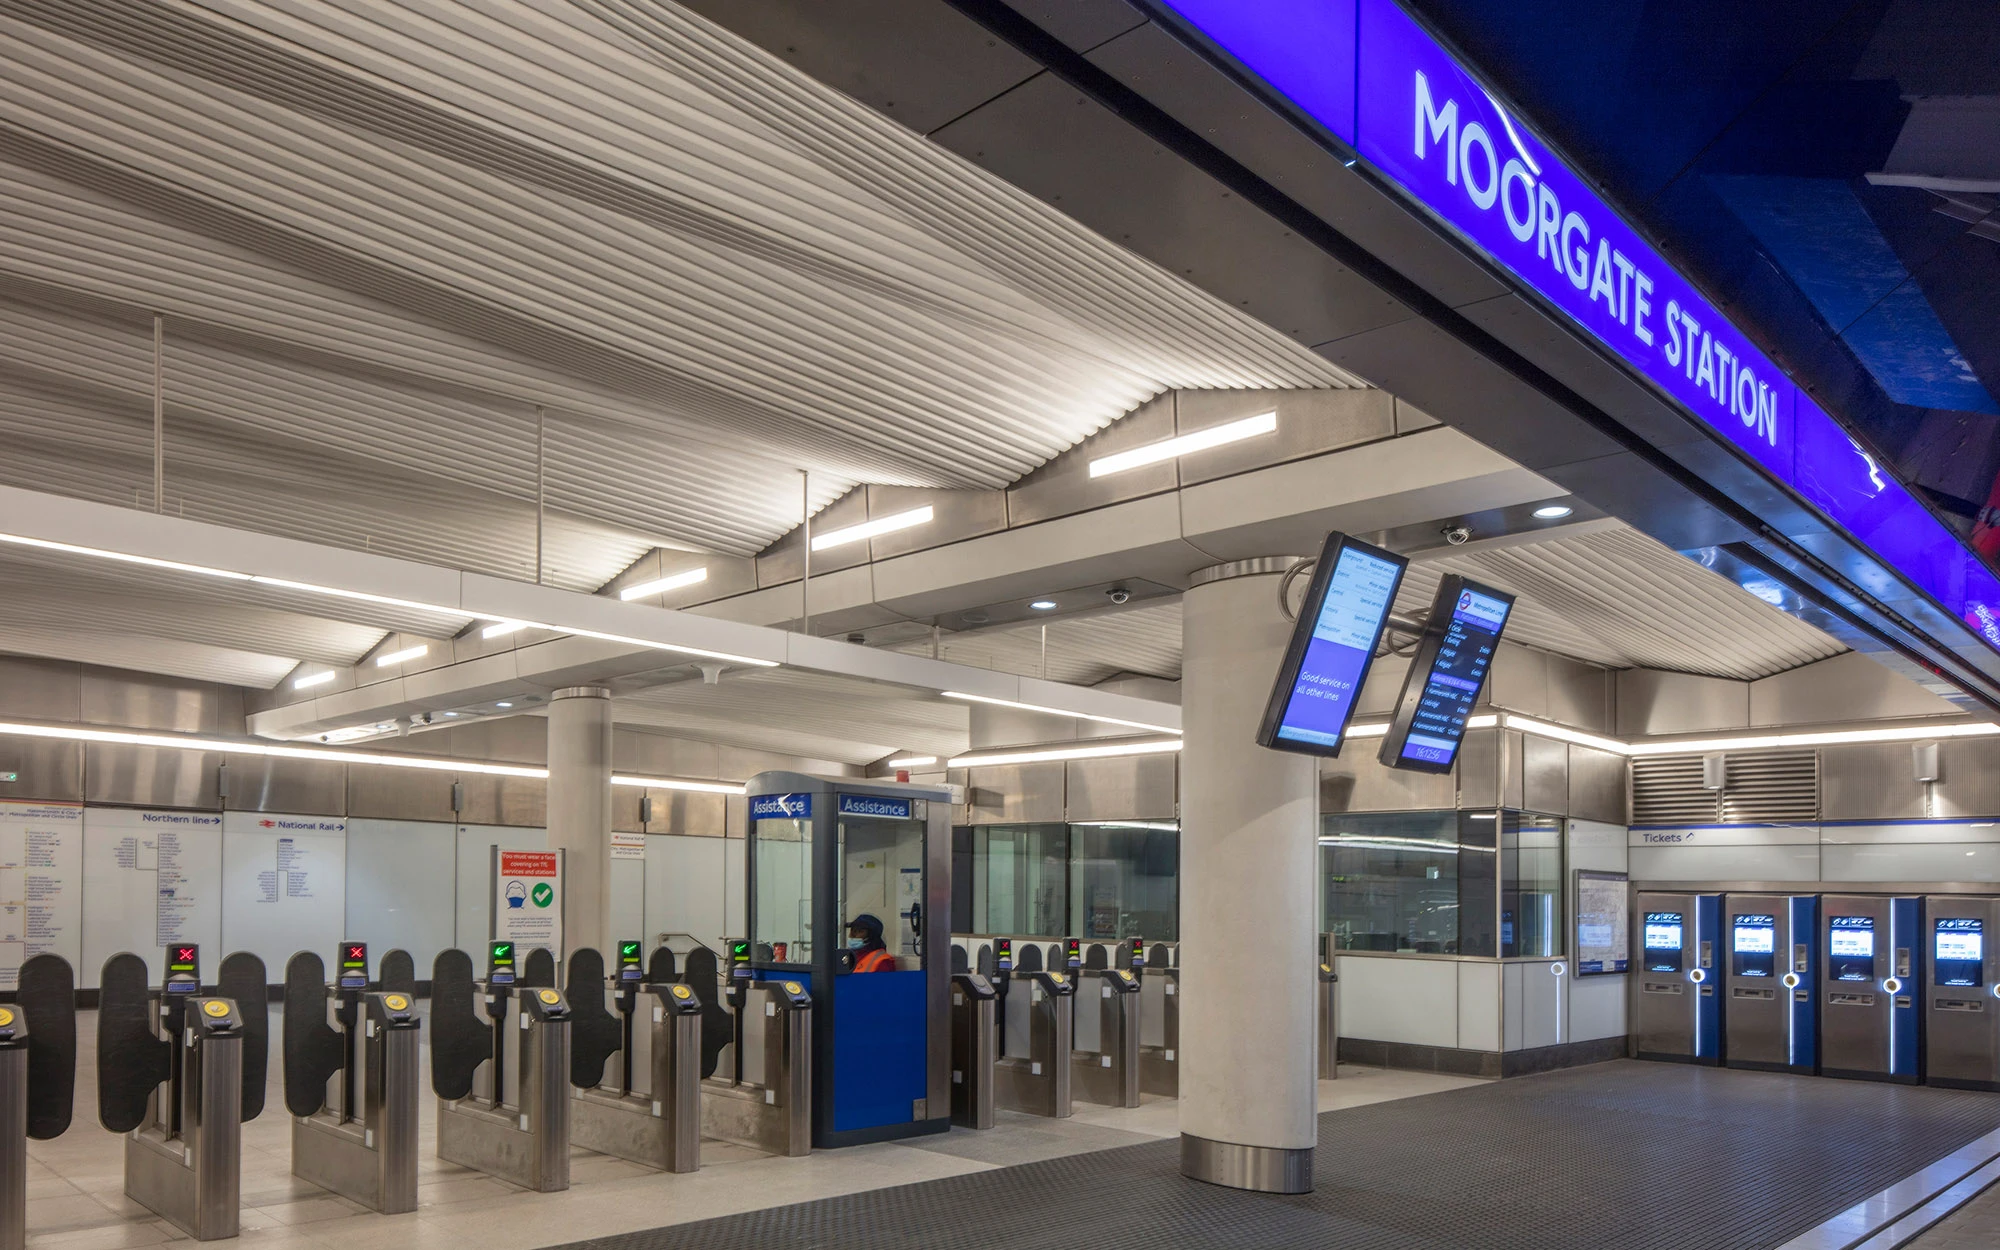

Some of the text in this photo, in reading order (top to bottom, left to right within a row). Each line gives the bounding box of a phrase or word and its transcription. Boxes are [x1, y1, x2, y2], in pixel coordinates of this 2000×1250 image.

[1413, 68, 1778, 446] MOORGATE STATION
[1301, 671, 1350, 690] Good service on
[1296, 686, 1339, 701] all other lines
[844, 799, 906, 816] Assistance
[142, 814, 210, 825] Northern line
[278, 820, 335, 832] National Rail
[1643, 833, 1682, 843] Tickets
[510, 861, 532, 869] covering
